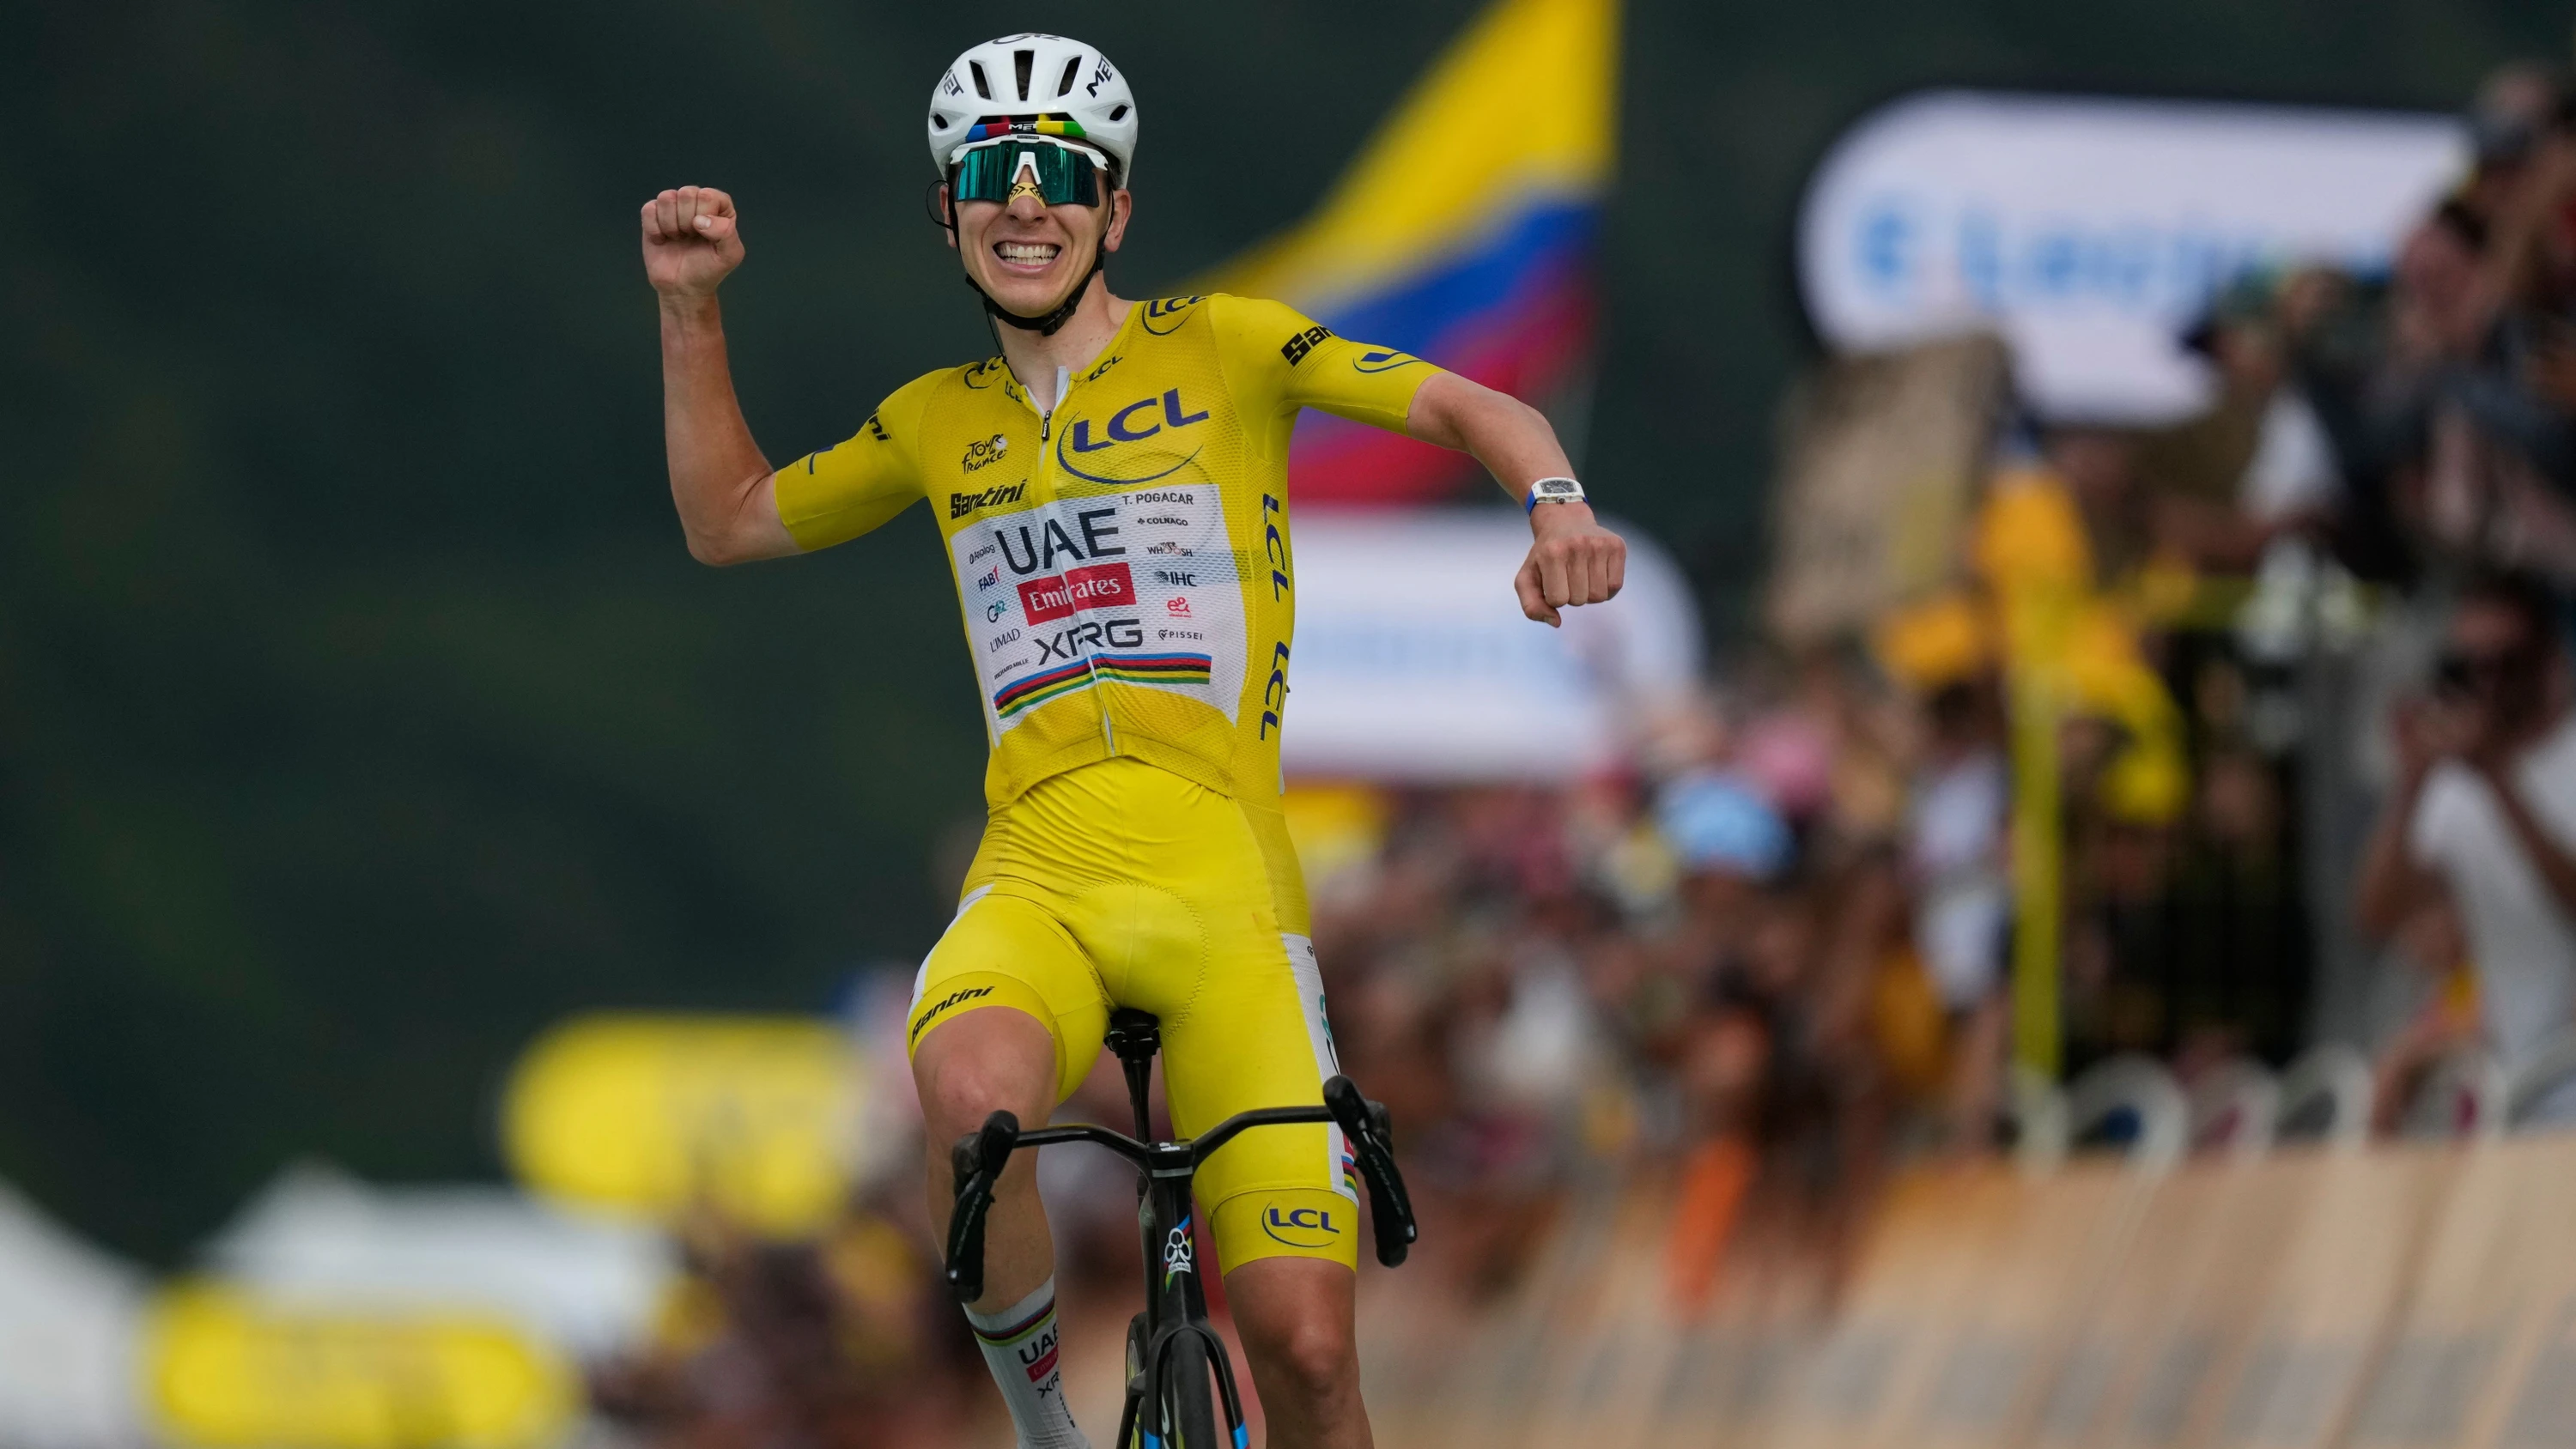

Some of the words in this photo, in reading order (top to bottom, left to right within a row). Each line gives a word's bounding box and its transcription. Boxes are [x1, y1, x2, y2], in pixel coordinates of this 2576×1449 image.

[1086, 54, 1113, 98] MET
[1089, 355, 1123, 382] LCL
[1072, 387, 1210, 453] LCL
[951, 478, 1028, 520] Santini
[1122, 495, 1133, 506] T.
[1136, 492, 1194, 506] POGACAR
[1146, 517, 1188, 526] COLNAGO
[994, 507, 1127, 575] UAE
[1262, 493, 1289, 603] LCL
[1029, 578, 1121, 612] Emirates
[1170, 571, 1198, 587] IHC
[1033, 618, 1144, 666] XRG
[1169, 631, 1203, 640] PISSEI
[1260, 640, 1289, 741] LCL
[1268, 1207, 1340, 1234] LCL
